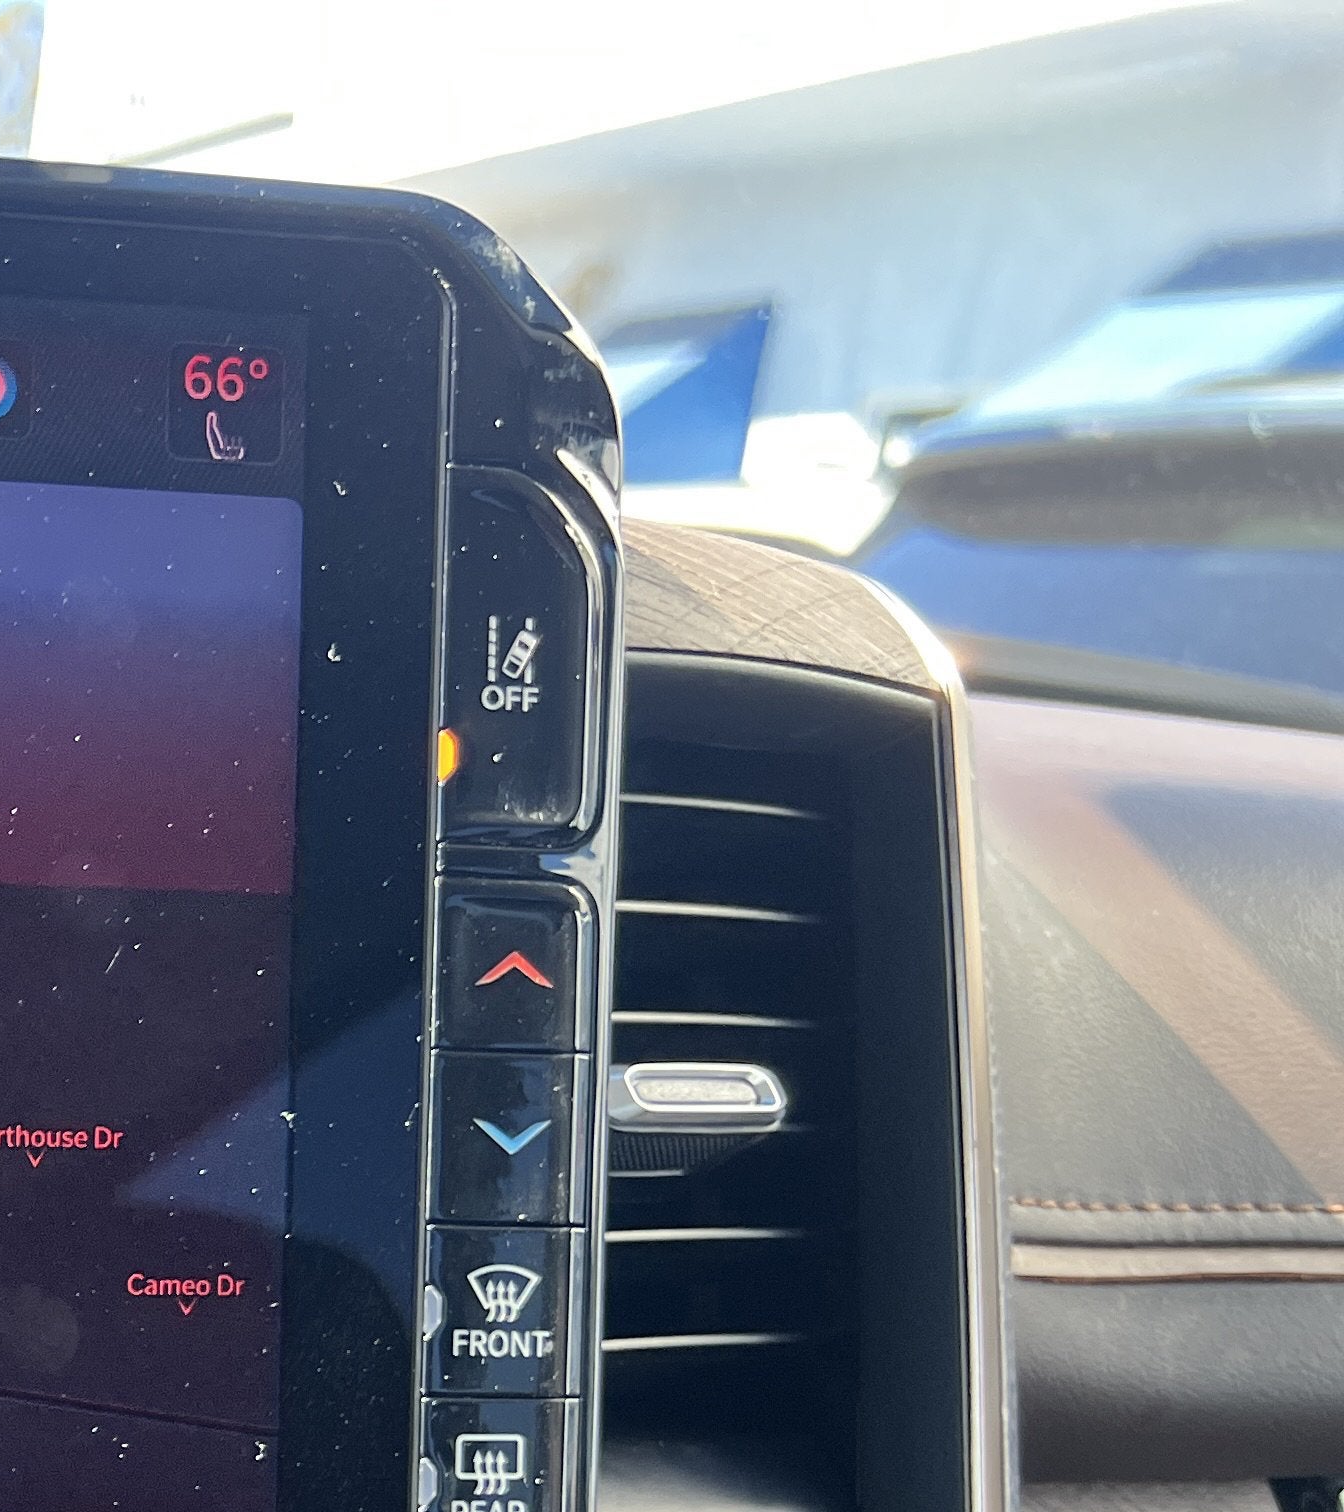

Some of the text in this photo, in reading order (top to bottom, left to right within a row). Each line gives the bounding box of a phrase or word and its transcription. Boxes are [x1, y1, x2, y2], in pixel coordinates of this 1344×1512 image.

[184, 355, 269, 402] 66°
[481, 684, 539, 712] OFF
[94, 1126, 123, 1149] Dr
[127, 1273, 245, 1297] Cameo Dr
[452, 1329, 551, 1358] FRONT
